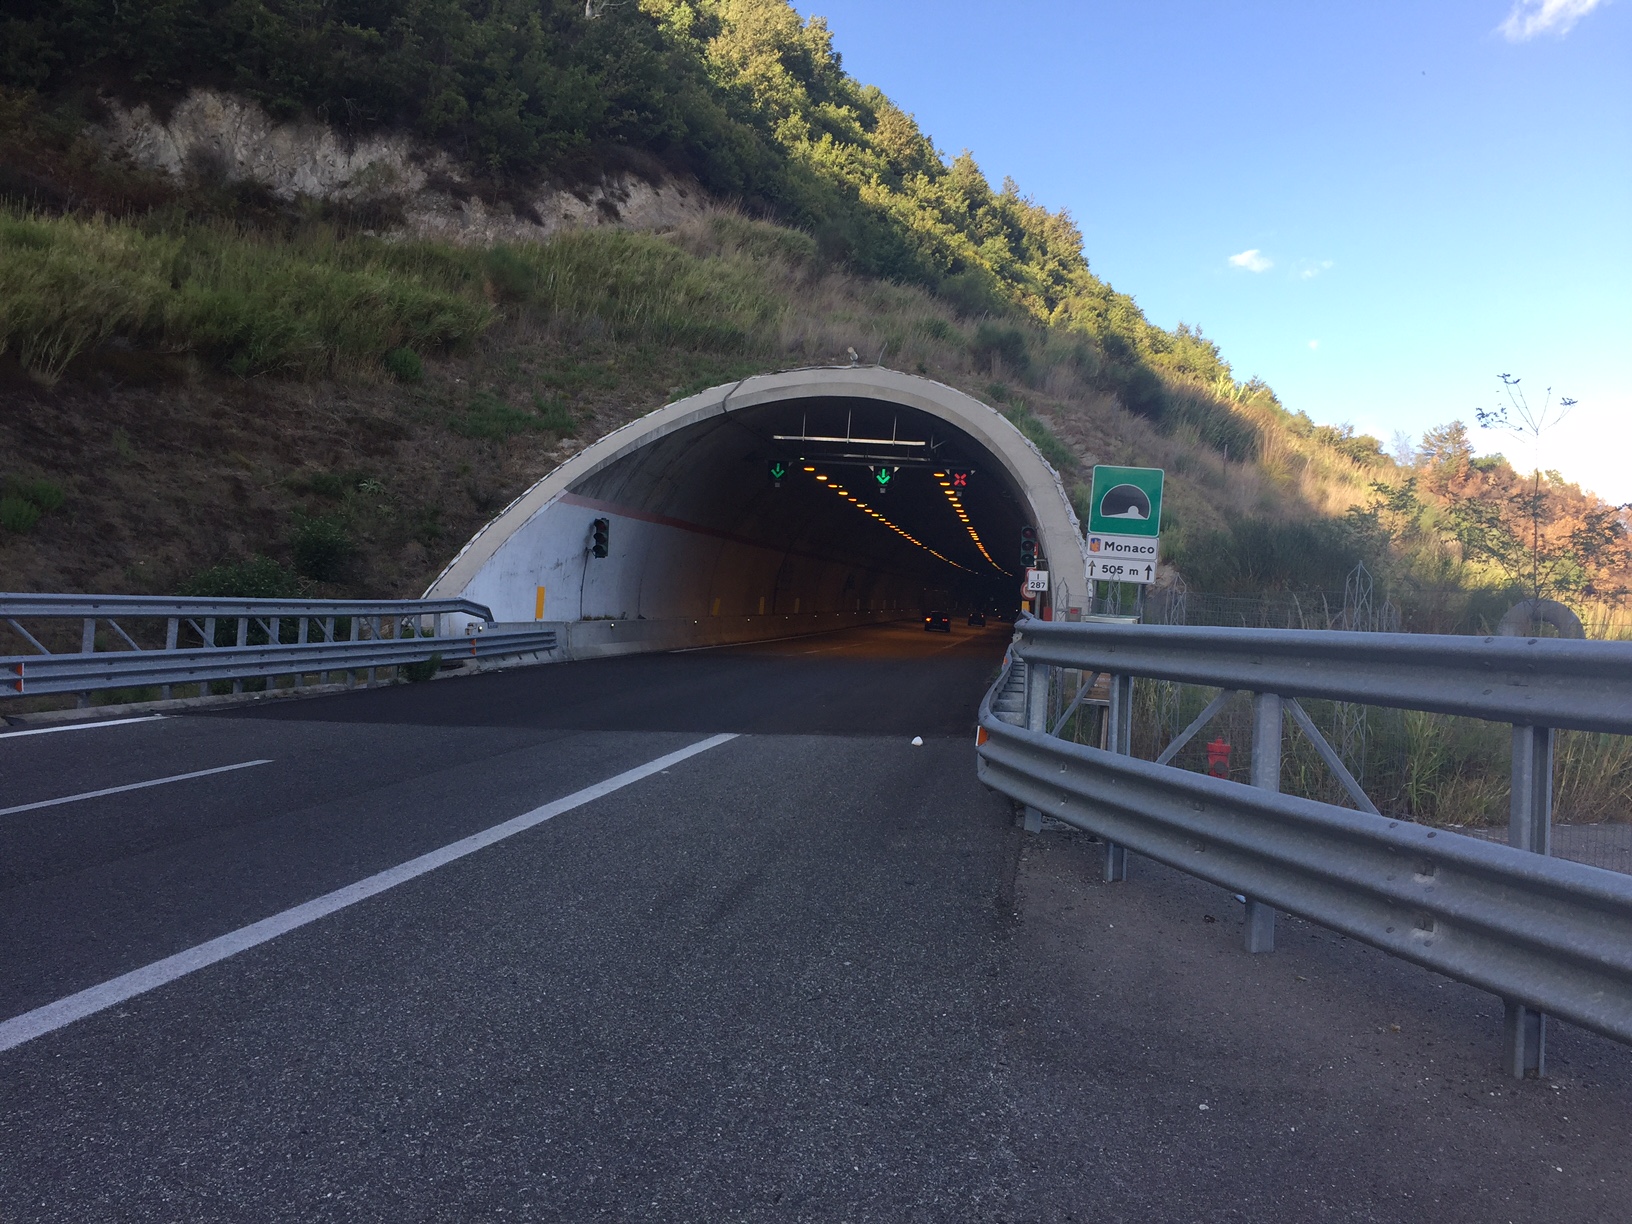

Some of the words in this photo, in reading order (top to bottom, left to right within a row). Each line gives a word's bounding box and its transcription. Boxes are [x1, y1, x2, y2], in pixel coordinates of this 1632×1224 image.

[1104, 541, 1155, 554] Monaco
[1101, 564, 1124, 575] 505
[1129, 568, 1139, 576] m
[1030, 581, 1046, 589] 287
